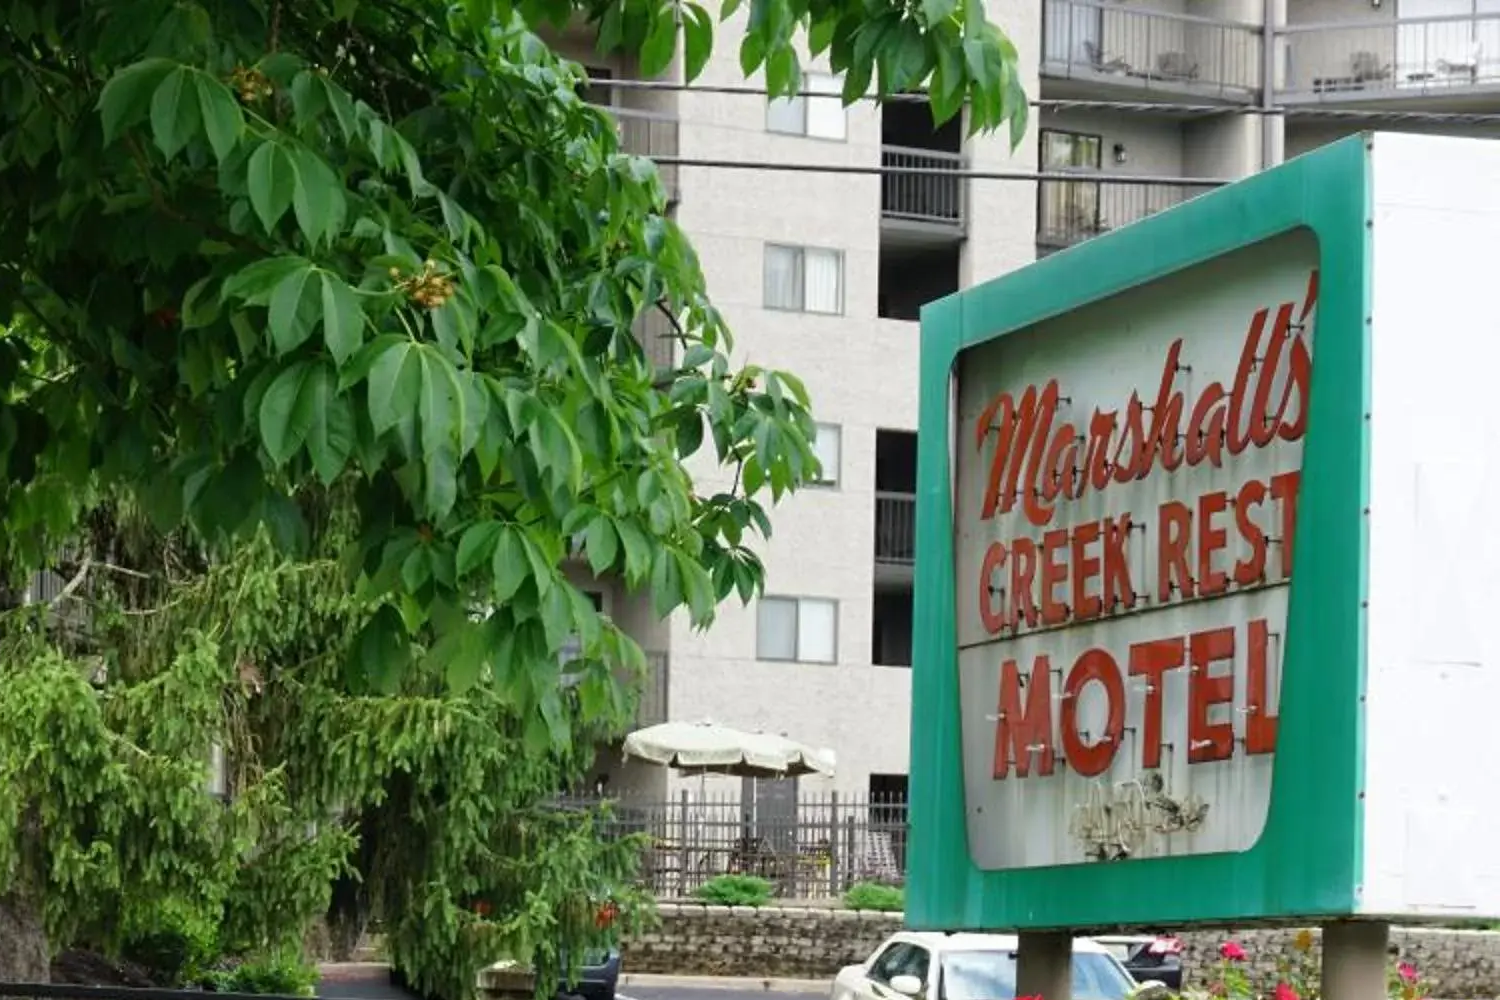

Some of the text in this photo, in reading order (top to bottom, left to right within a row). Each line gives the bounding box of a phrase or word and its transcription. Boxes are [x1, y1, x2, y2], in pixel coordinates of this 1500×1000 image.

[976, 269, 1318, 526] Marshall's
[979, 471, 1300, 635] CREEK REST
[994, 620, 1279, 780] MOTEL
